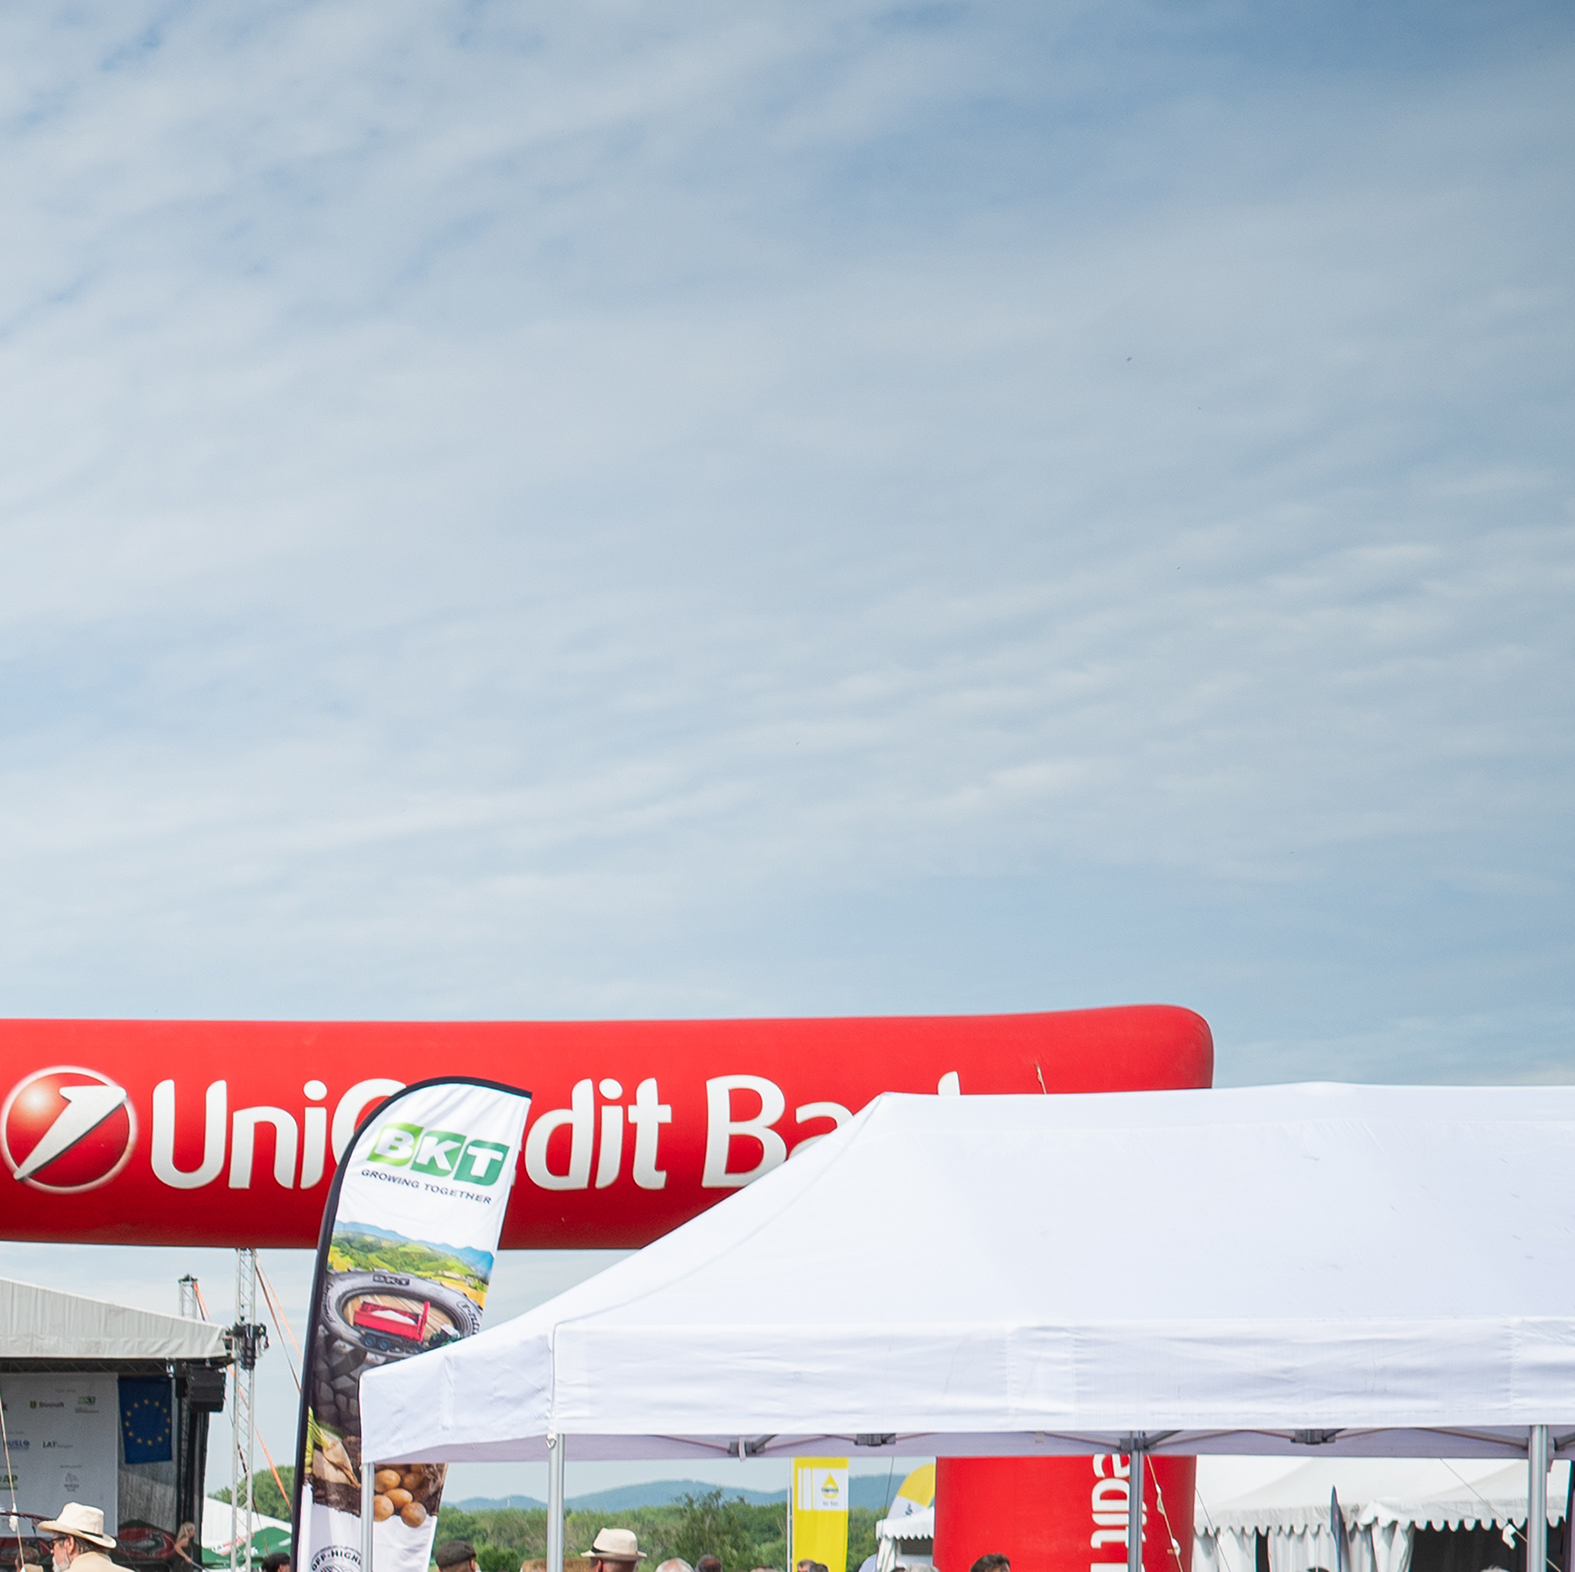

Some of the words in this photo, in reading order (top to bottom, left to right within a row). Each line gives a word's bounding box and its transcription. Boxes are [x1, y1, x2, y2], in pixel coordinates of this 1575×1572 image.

[151, 1077, 671, 1191] UniCdit
[372, 1125, 506, 1181] BKT
[360, 1168, 420, 1190] GROWING
